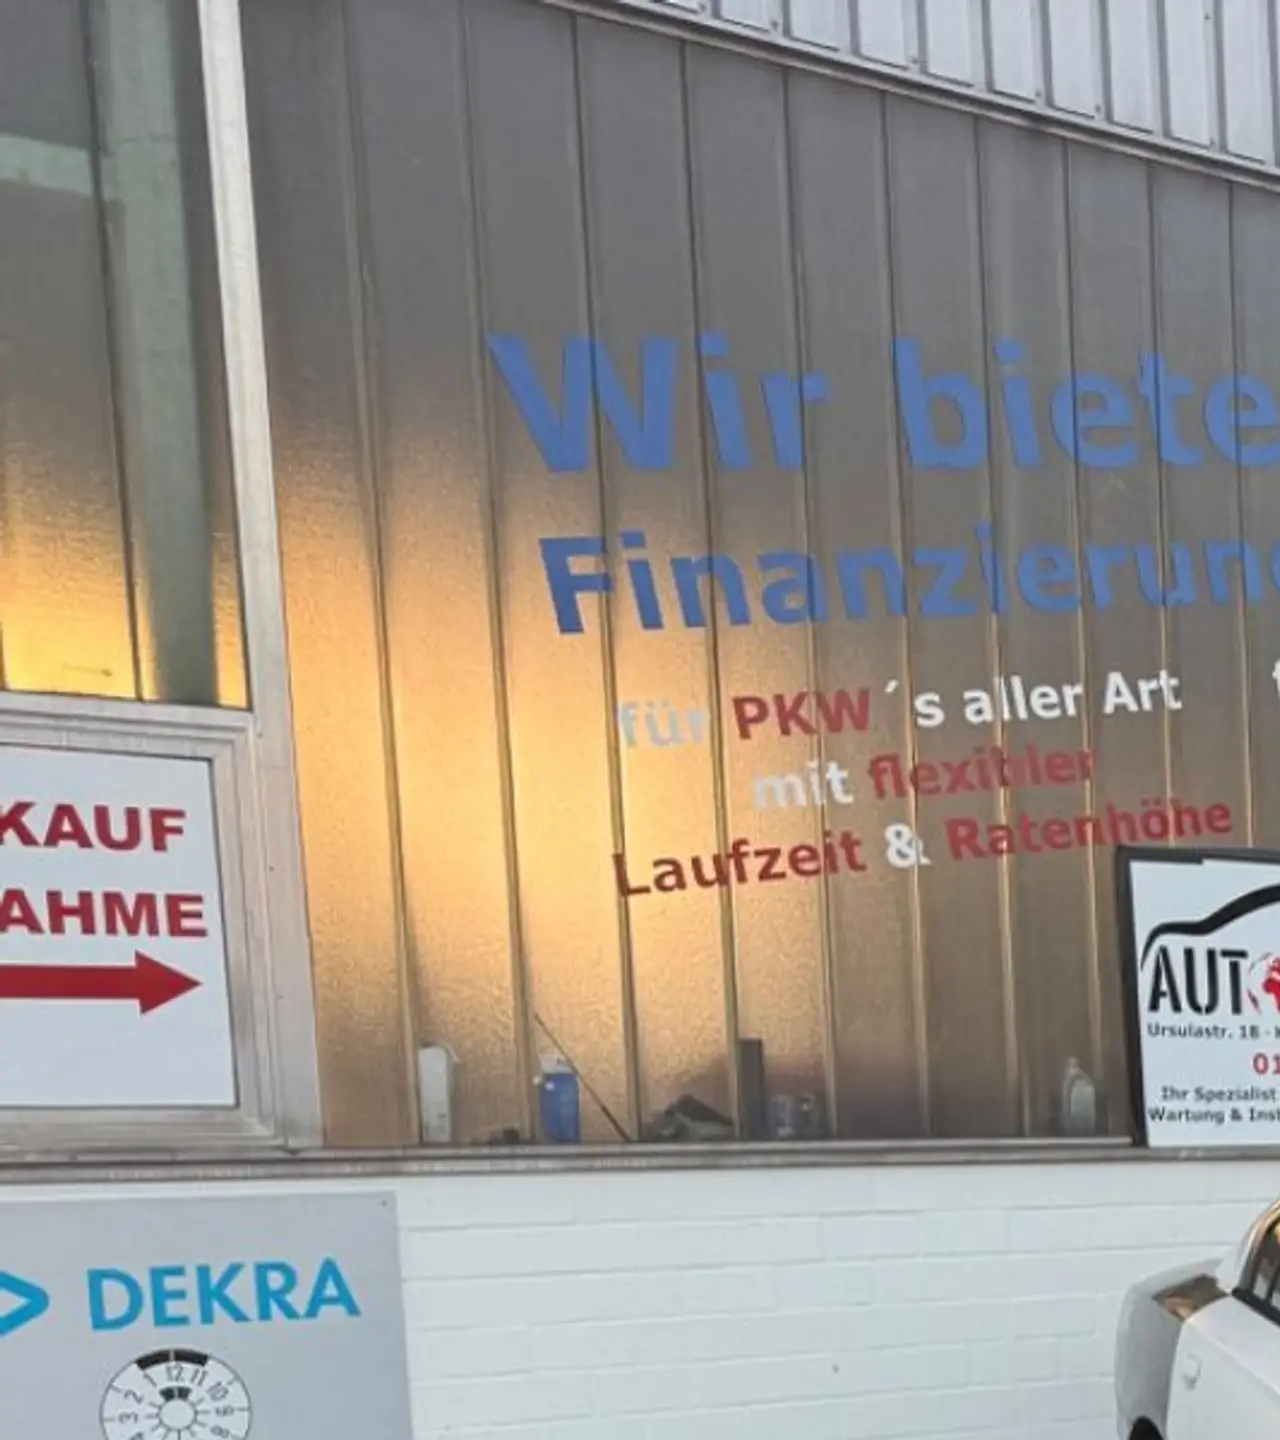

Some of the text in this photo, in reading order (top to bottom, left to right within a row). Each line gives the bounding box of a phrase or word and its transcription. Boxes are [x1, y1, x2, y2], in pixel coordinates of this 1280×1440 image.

[488, 330, 833, 472] Wir
[618, 699, 709, 748] für
[964, 676, 1085, 725] aller
[1103, 670, 1183, 714] Art
[752, 745, 1094, 808] mit flexibler
[0, 801, 187, 853] KAUF
[613, 799, 1234, 897] Laufzeit & Ratenhöhe
[0, 888, 208, 938] AHME
[1149, 1106, 1225, 1124] Wartung
[1195, 1086, 1277, 1103] Spezialist
[86, 1257, 361, 1331] DEKRA
